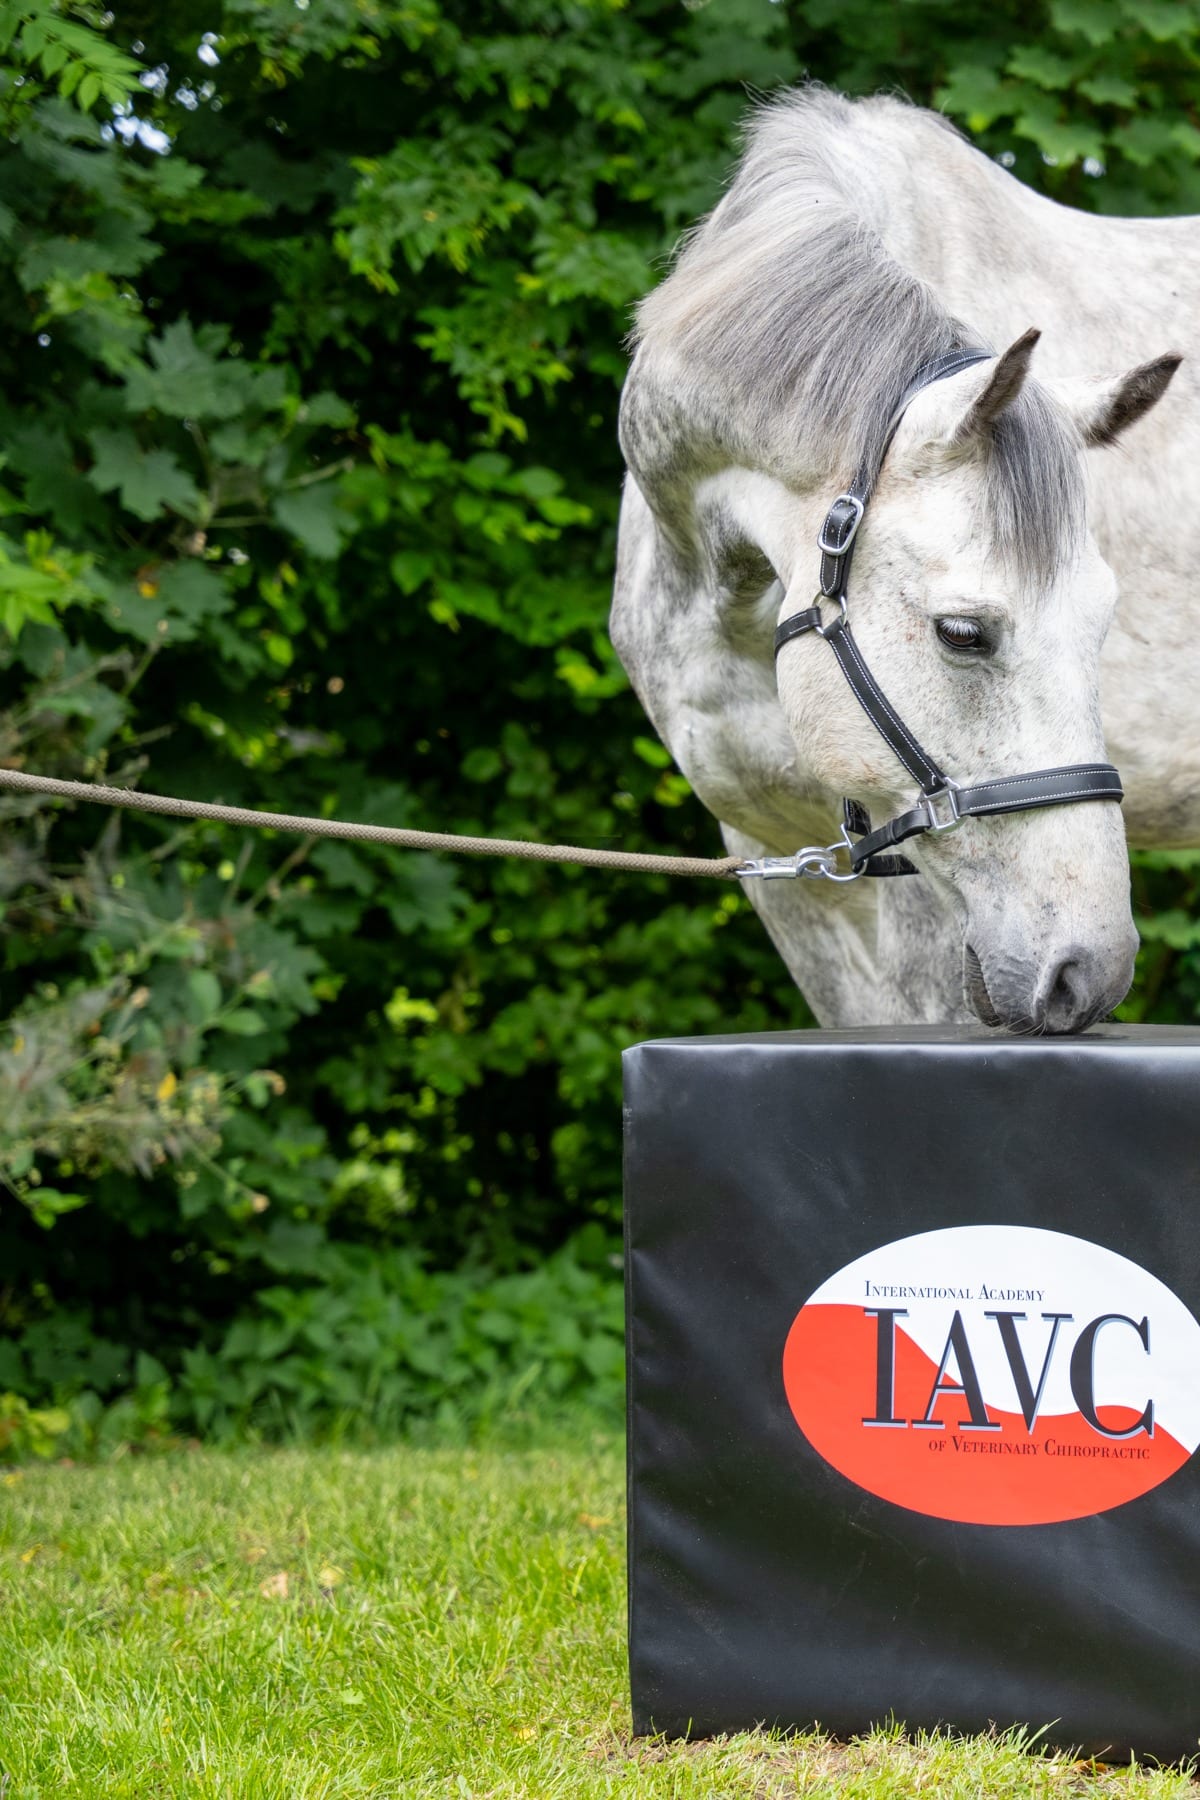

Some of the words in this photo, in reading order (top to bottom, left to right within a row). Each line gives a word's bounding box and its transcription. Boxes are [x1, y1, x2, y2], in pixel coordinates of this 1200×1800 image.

[864, 1280, 974, 1300] INTERNATIONAL
[978, 1283, 1045, 1302] ACADEMY
[861, 1307, 1155, 1439] IAVC
[928, 1439, 947, 1453] OF
[951, 1435, 1040, 1456] VETERINARY
[1044, 1438, 1151, 1460] CHIROPRACTIC
